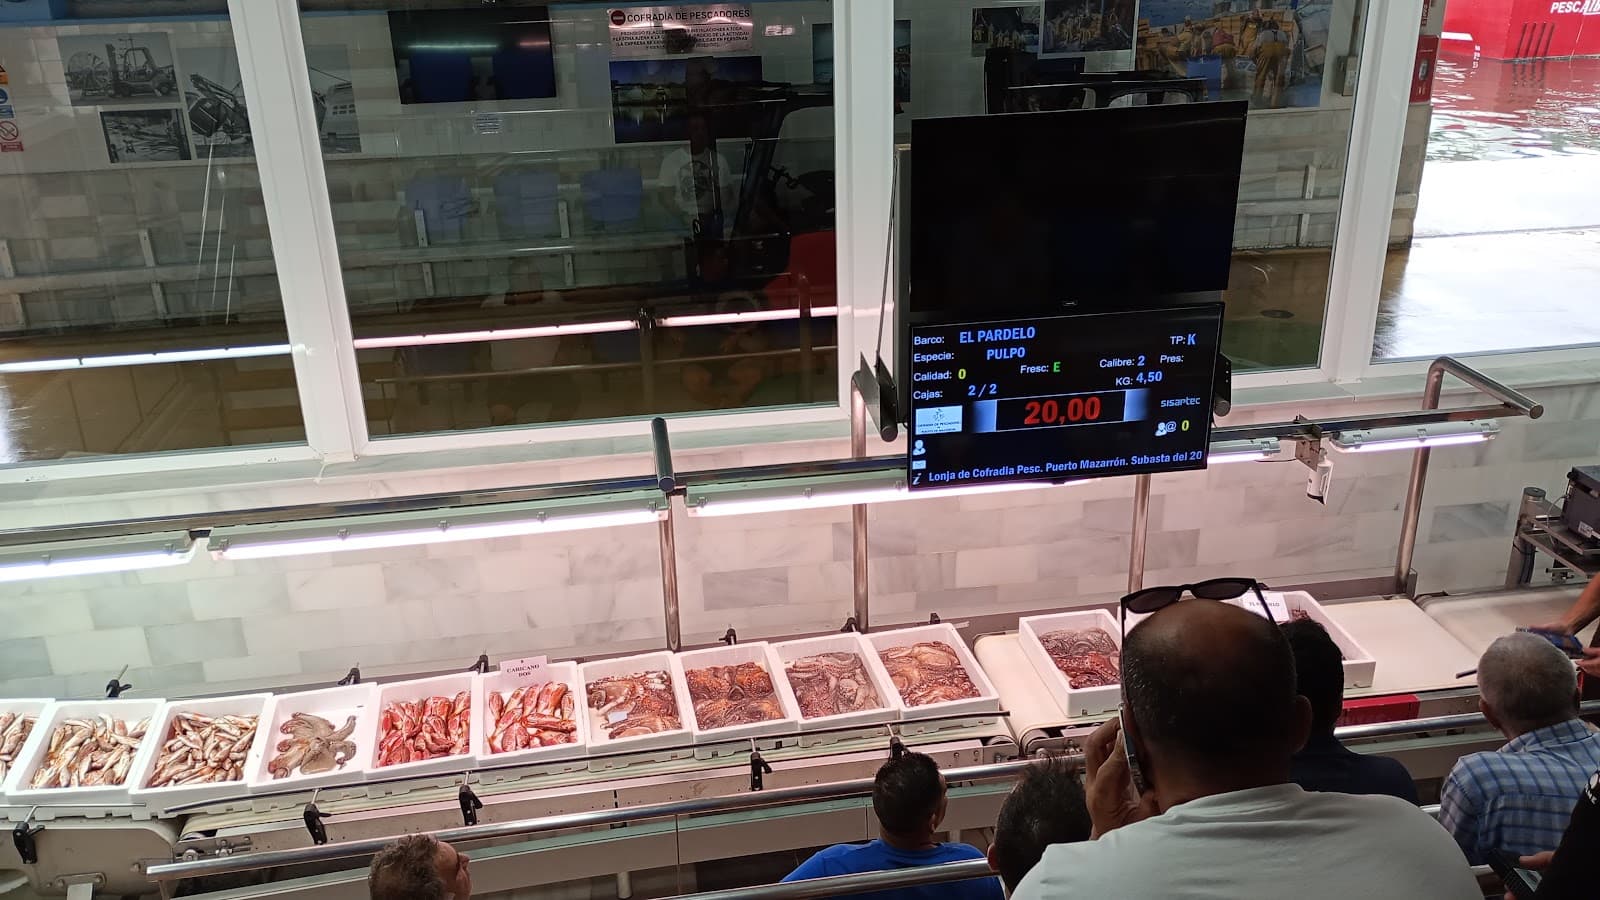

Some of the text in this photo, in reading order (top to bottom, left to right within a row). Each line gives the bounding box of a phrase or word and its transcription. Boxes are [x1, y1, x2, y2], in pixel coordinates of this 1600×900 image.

[675, 12, 688, 20] DE
[690, 9, 750, 20] PESCADORES
[914, 326, 1036, 346] Barco: EL PARDELO
[1170, 333, 1197, 345] TP: K
[914, 347, 1026, 363] Especie: PULPO
[1100, 355, 1145, 368] Calibre: 2
[1160, 354, 1184, 364] Pres:
[1020, 361, 1061, 374] Fresc: E
[913, 368, 967, 382] Calidad: 0
[1115, 371, 1163, 386] KG: 4,50
[913, 390, 943, 400] Cajas:
[968, 385, 976, 396] 2
[989, 383, 997, 395] 2
[1024, 396, 1101, 425] 20,00
[1181, 419, 1190, 431] 0
[928, 470, 955, 482] Lonja
[958, 468, 970, 479] de
[1016, 464, 1043, 475] Pesc.
[1046, 461, 1078, 473] Puerto
[1080, 456, 1128, 470] Mazarrón.
[1131, 453, 1171, 465] Subasta
[1172, 452, 1188, 462] del
[1189, 450, 1203, 461] 20
